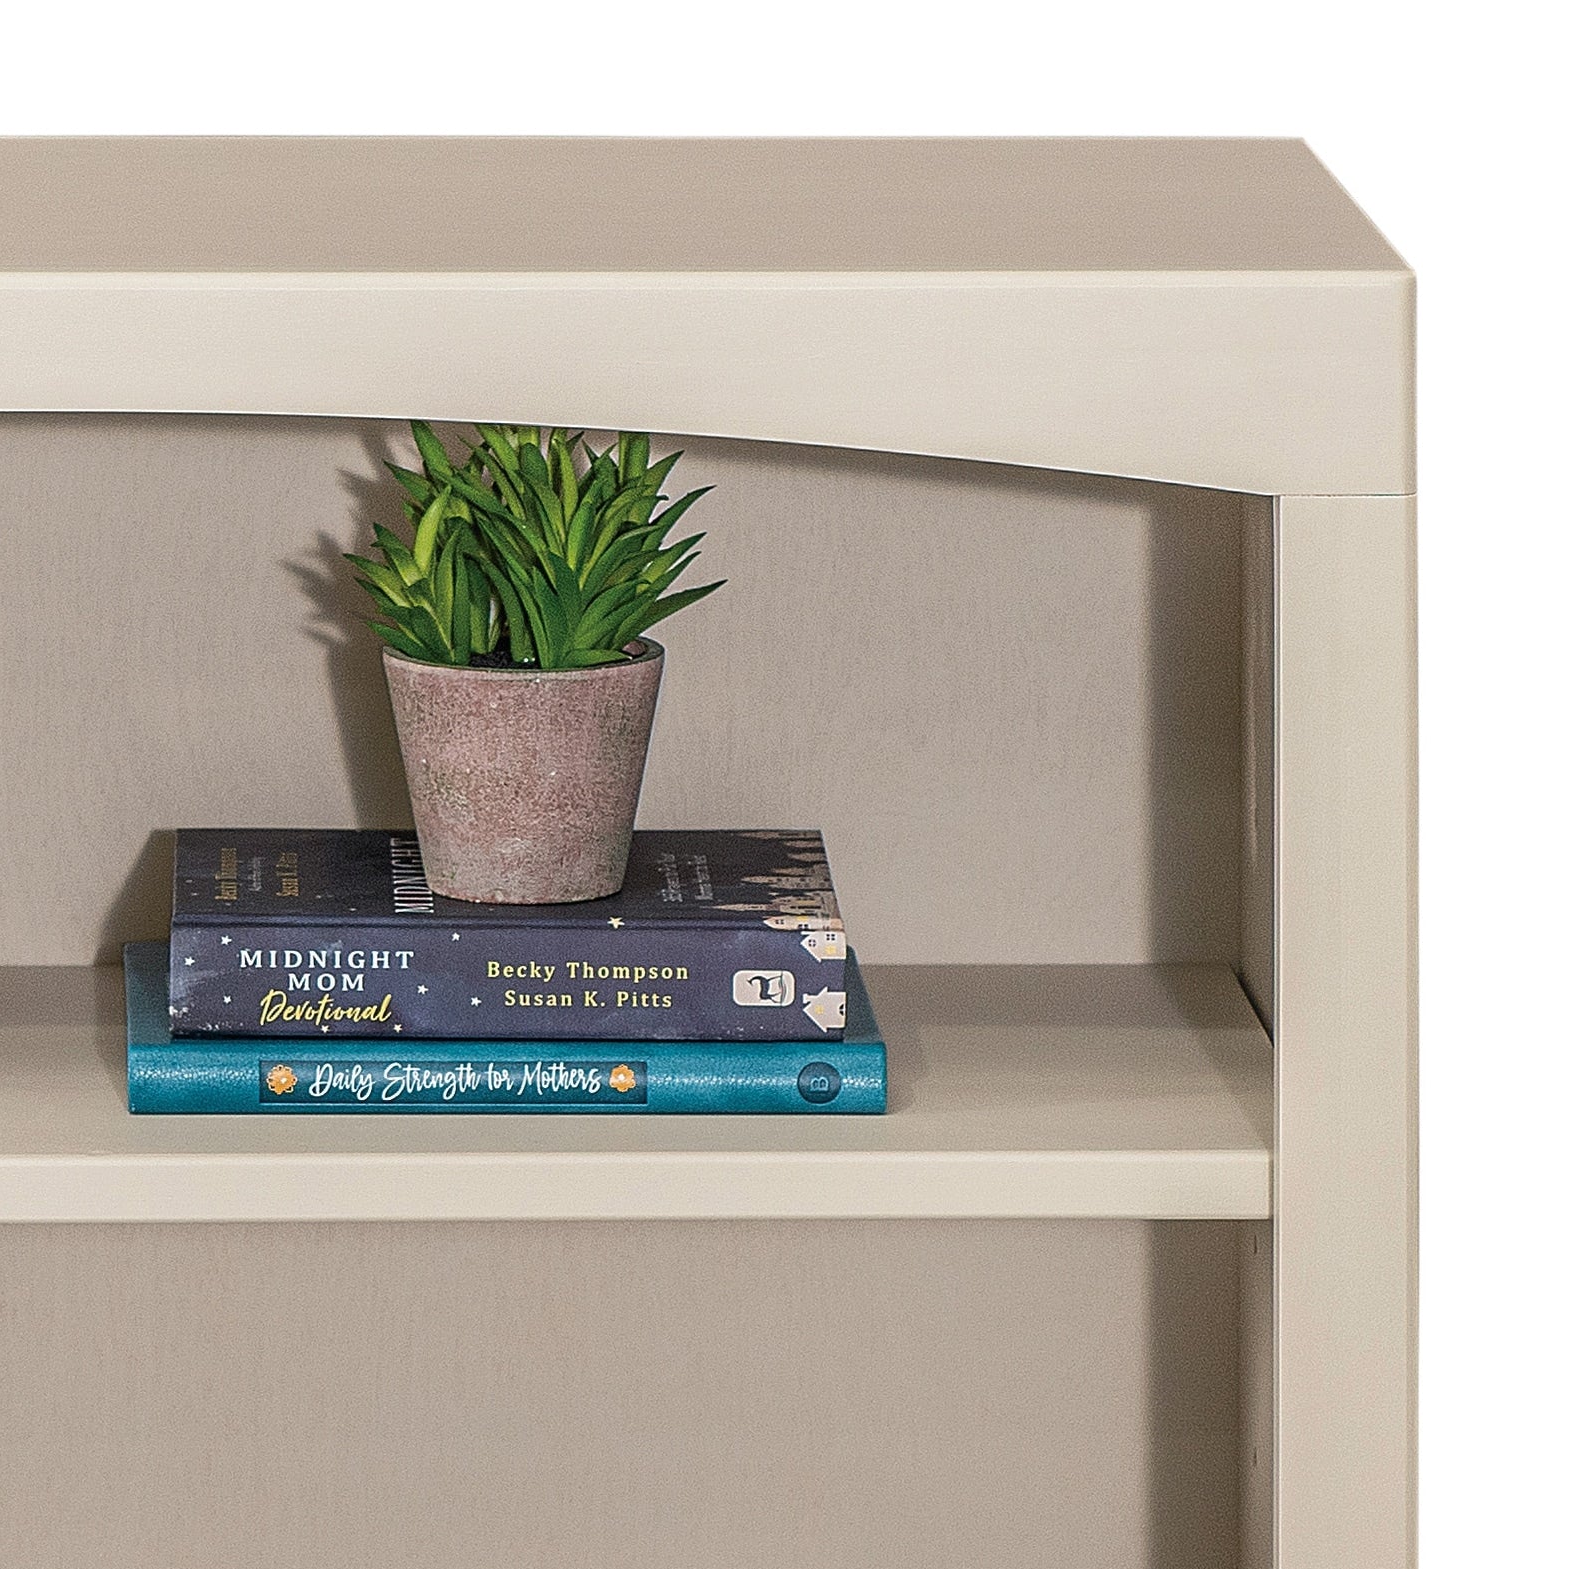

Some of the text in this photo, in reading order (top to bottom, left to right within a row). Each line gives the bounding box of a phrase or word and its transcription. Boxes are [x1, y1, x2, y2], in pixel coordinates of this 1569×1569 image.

[239, 950, 415, 969] MIDNIGHT
[486, 960, 689, 983] Becky Thompson
[288, 973, 365, 992] MOM
[259, 988, 393, 1026] Devotional
[504, 989, 673, 1008] Susan K. Pitts
[308, 1061, 602, 1101] Daily Strength for Mothers
